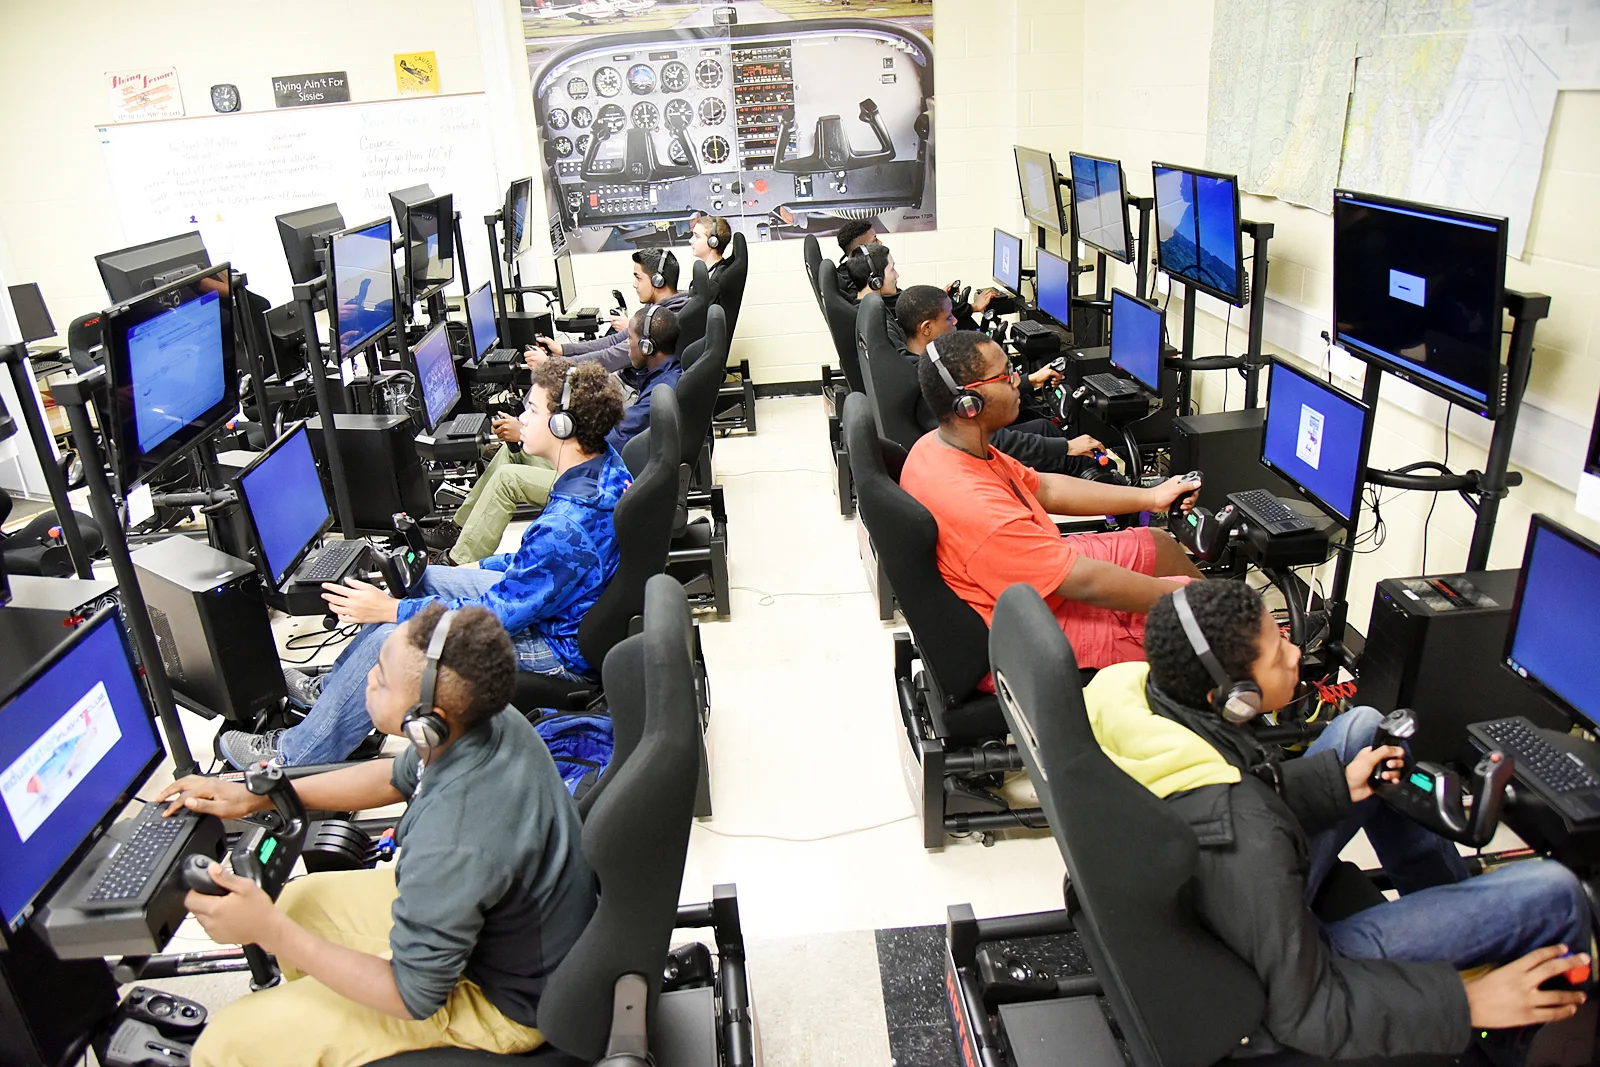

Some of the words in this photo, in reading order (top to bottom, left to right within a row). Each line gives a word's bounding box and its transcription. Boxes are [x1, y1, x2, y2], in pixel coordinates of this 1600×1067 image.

[414, 55, 434, 73] CAUTION
[109, 74, 142, 89] Flying
[143, 71, 174, 89] Lessons
[274, 81, 302, 93] Flying
[304, 78, 327, 89] Ain't
[328, 77, 344, 88] For
[298, 91, 325, 102] Sissies
